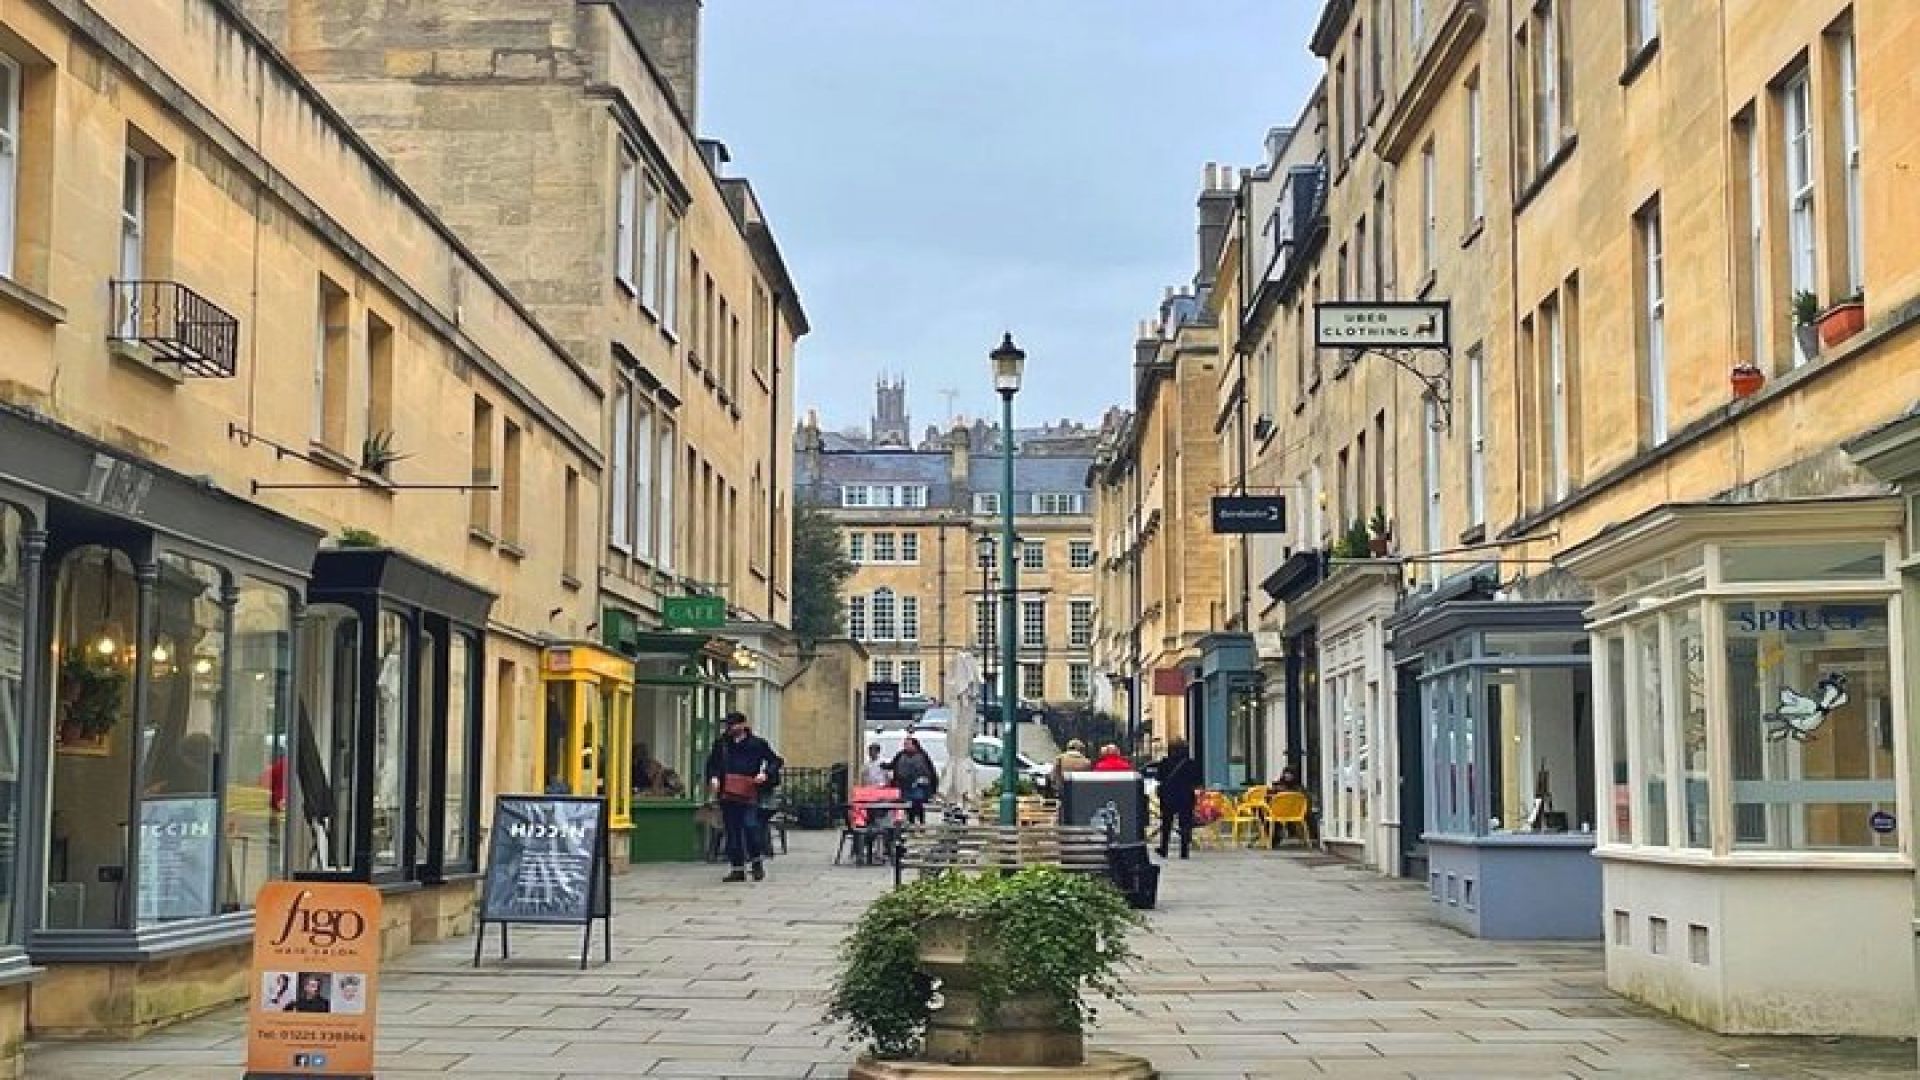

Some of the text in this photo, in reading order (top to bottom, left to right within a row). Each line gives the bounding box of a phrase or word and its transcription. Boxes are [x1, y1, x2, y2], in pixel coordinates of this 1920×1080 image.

[1343, 312, 1388, 323] UBER
[1322, 327, 1409, 336] CLOTHING
[269, 890, 365, 947] figo
